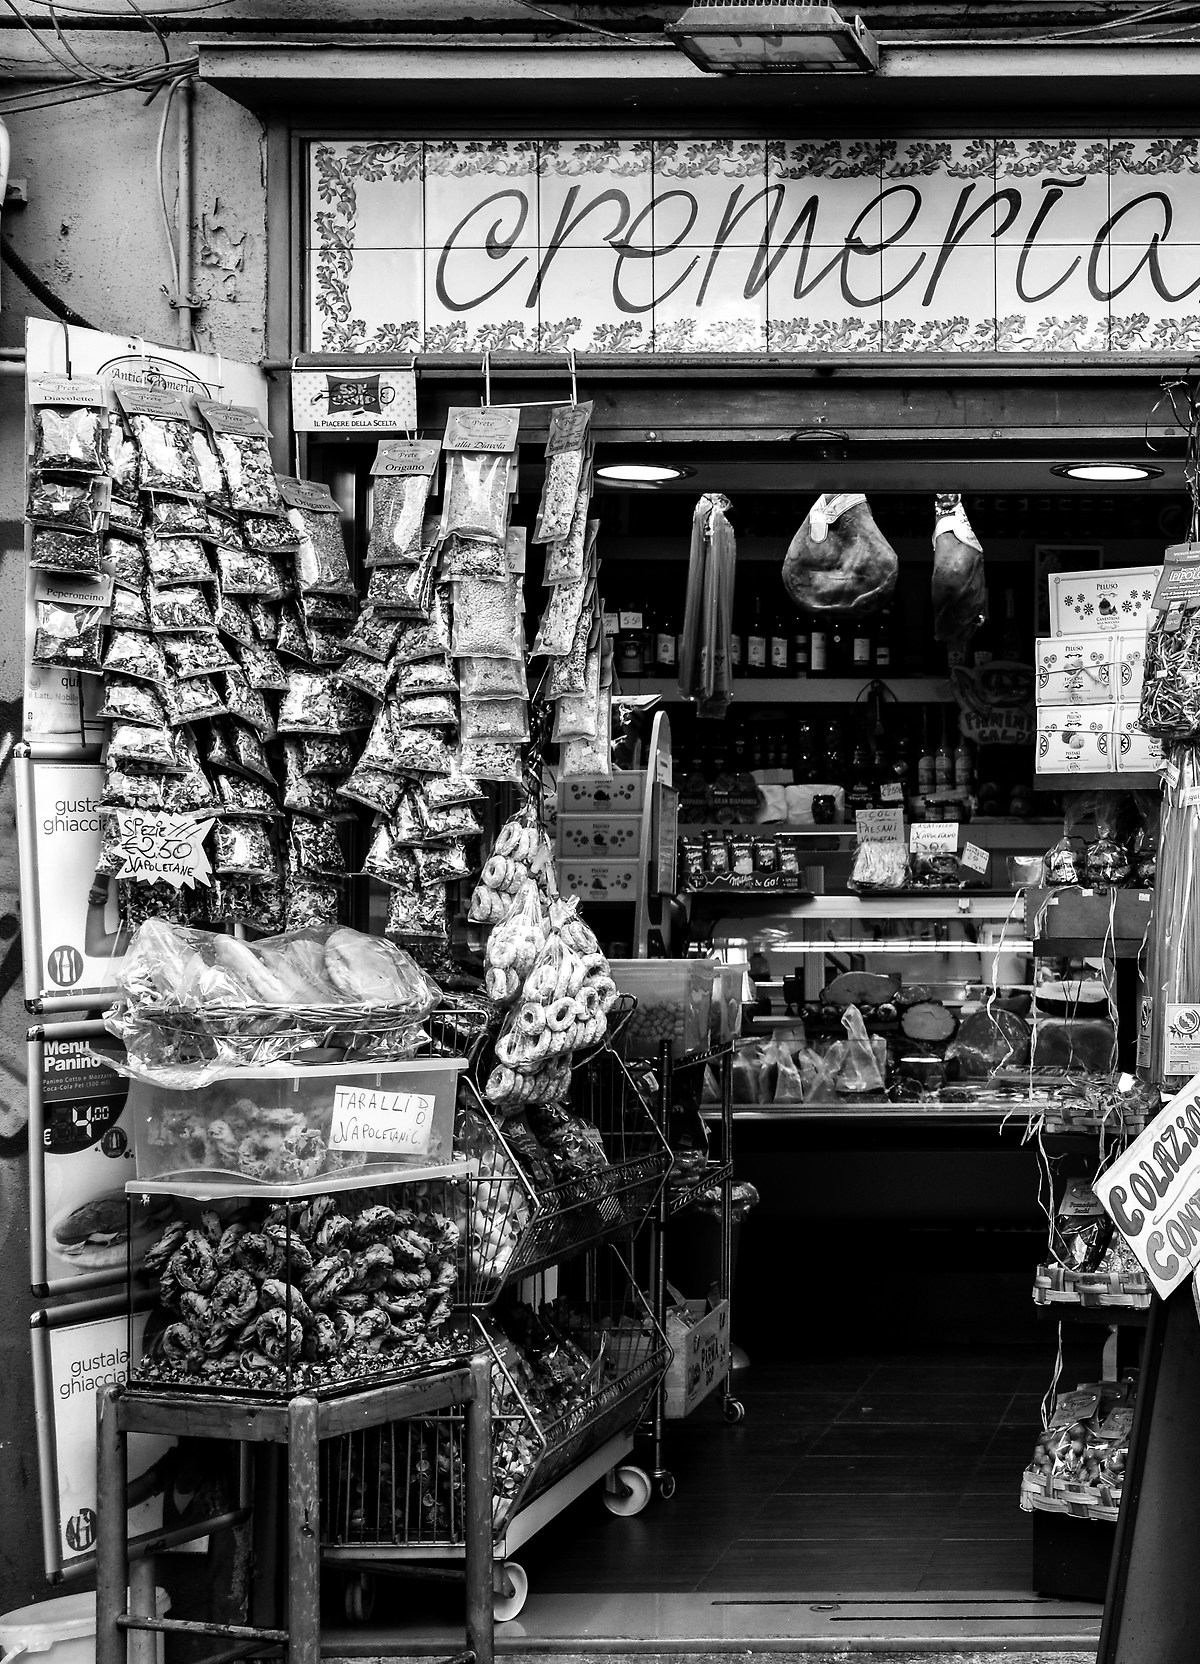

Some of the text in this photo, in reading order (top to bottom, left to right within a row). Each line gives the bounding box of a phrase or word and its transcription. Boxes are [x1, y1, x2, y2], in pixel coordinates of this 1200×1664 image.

[314, 420, 320, 428] IL
[321, 420, 350, 429] PIACERE
[373, 420, 397, 428] SCELTA
[474, 441, 507, 450] Diavola
[385, 463, 425, 473] Origano
[46, 587, 104, 601] Peperoncino
[1096, 583, 1119, 591] PELUSO
[124, 855, 195, 877] NAPOLETANE
[43, 1040, 90, 1056] Menu
[44, 1053, 102, 1073] Panino
[336, 1092, 413, 1113] TARALLI
[70, 1348, 130, 1377] gustala
